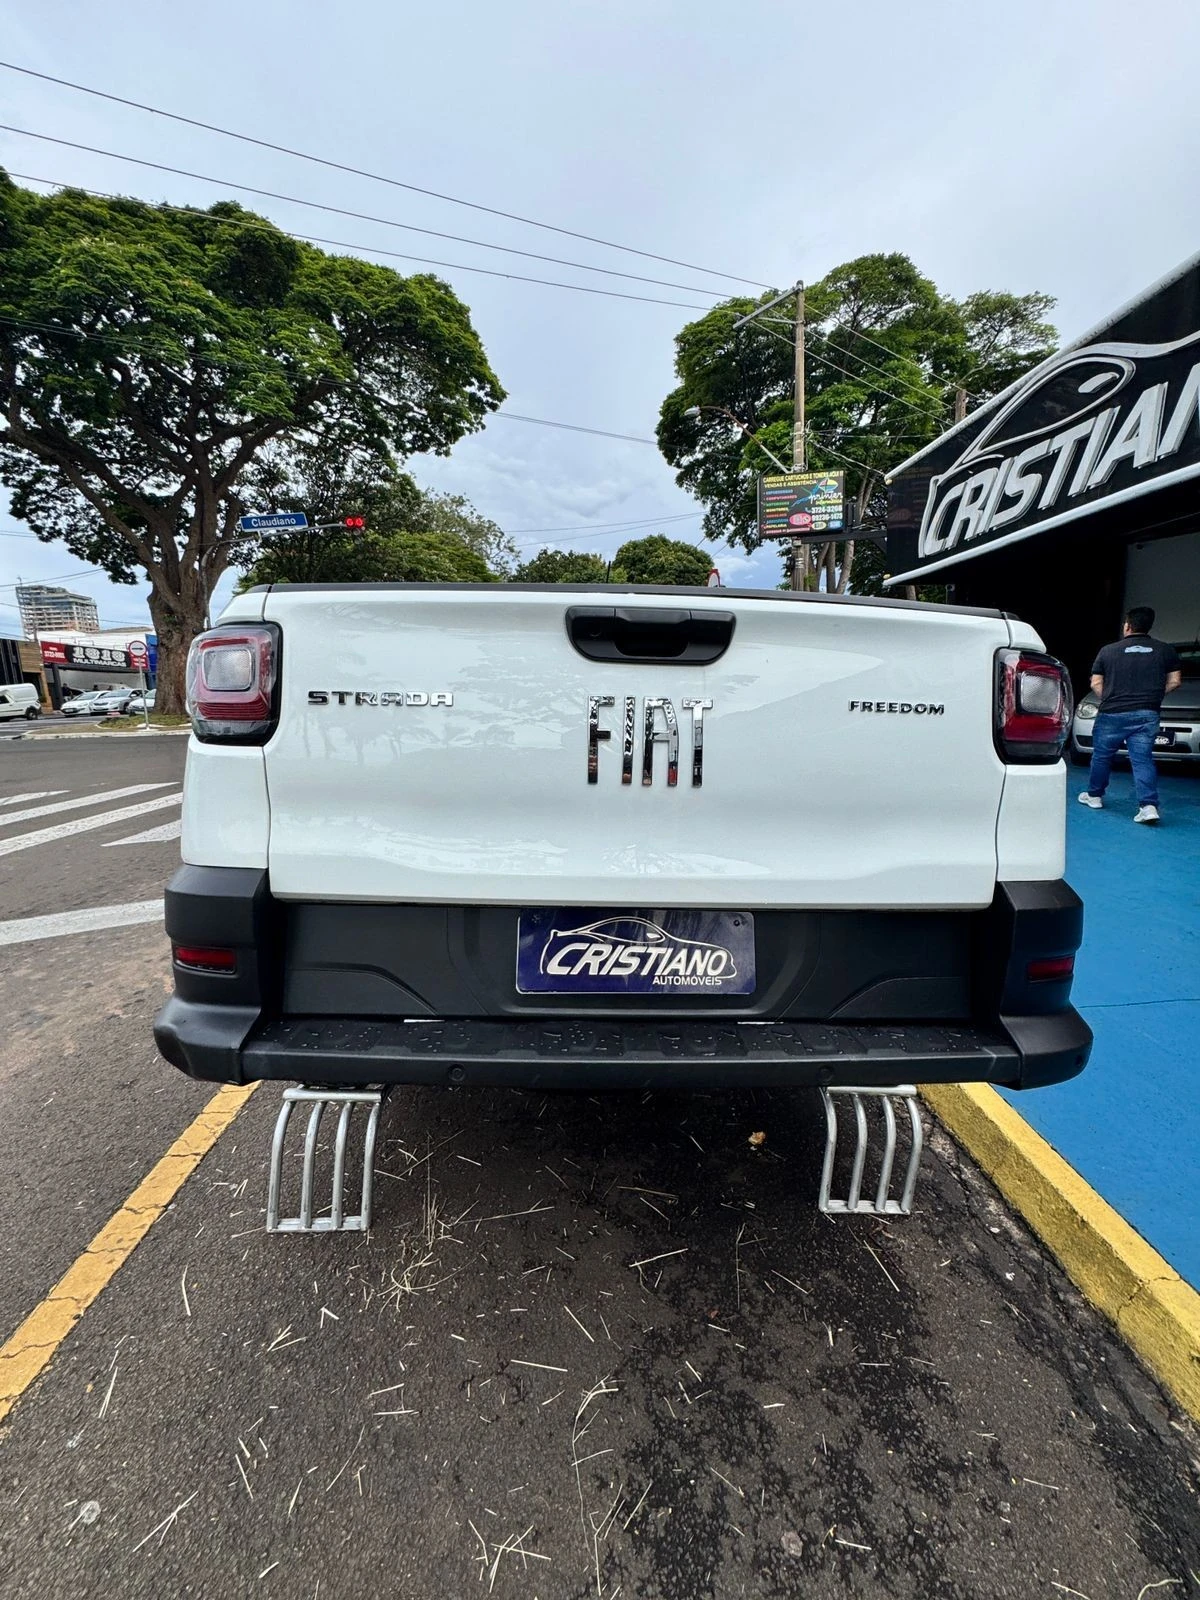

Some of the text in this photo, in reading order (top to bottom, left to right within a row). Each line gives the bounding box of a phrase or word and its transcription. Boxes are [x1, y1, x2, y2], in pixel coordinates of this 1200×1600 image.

[251, 517, 296, 527] Claudiano
[73, 657, 127, 667] MULTIMARCAS
[308, 690, 454, 707] STRADA
[848, 700, 945, 715] FREEDOM
[587, 695, 714, 788] FIAT
[546, 942, 728, 976] CRISTIANO
[652, 974, 722, 986] AUTOMÓVEIS
